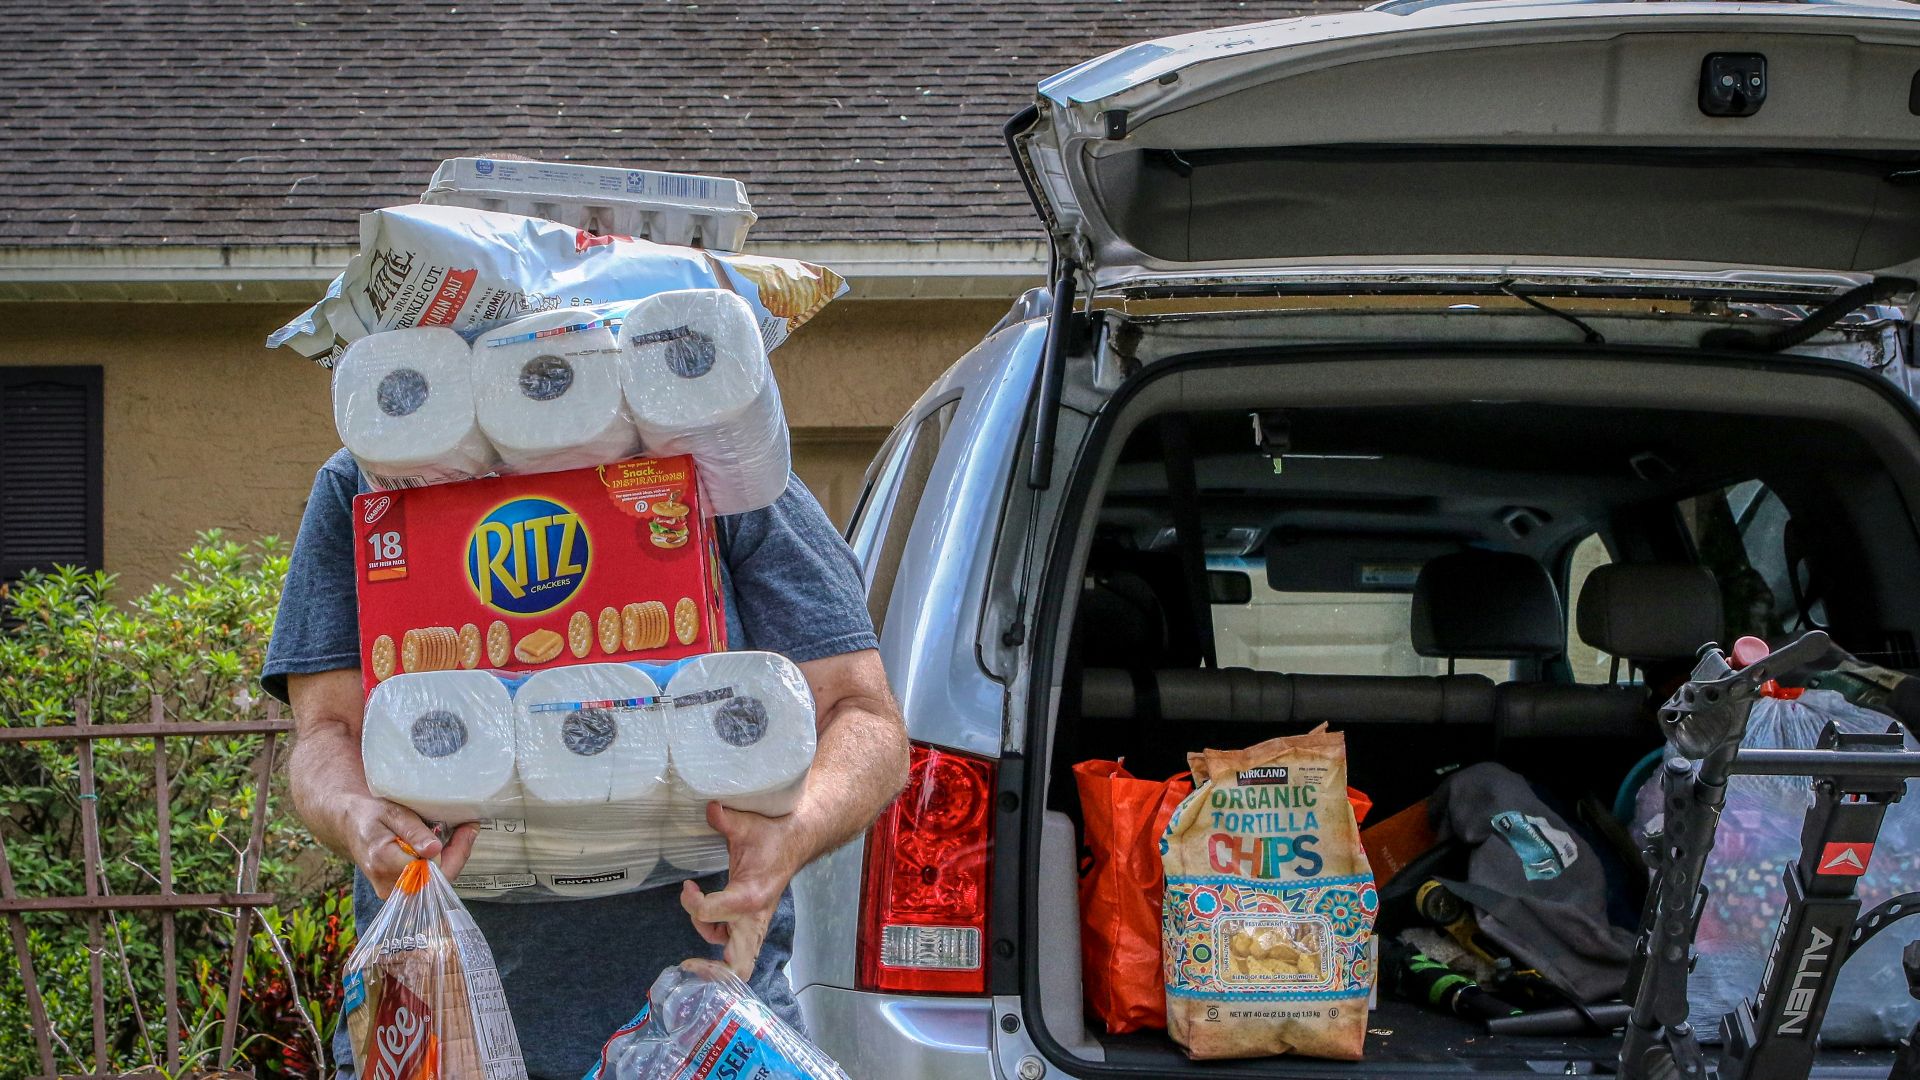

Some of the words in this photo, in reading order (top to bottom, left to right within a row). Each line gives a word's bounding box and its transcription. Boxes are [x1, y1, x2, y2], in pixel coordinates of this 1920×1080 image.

[394, 284, 415, 312] BRAND
[442, 276, 463, 299] SALT
[483, 289, 507, 320] PROMISE
[612, 471, 685, 488] INSPIRATIONS!
[623, 466, 655, 478] Snack
[366, 498, 388, 521] NABISCO
[368, 531, 402, 561] 18
[476, 513, 582, 605] RITZ
[530, 579, 571, 593] CRACKERS
[1239, 768, 1287, 779] KIRKLAND
[1211, 784, 1317, 809] ORGANIC
[1211, 811, 1319, 833] TORTILLA
[1208, 833, 1323, 879] CHIPS
[557, 873, 621, 885] KIRKLAND
[1777, 926, 1833, 1035] ALLEN
[1301, 1010, 1312, 1018] 1.13
[1312, 1009, 1320, 1019] kg
[697, 1043, 723, 1079] SOURCE
